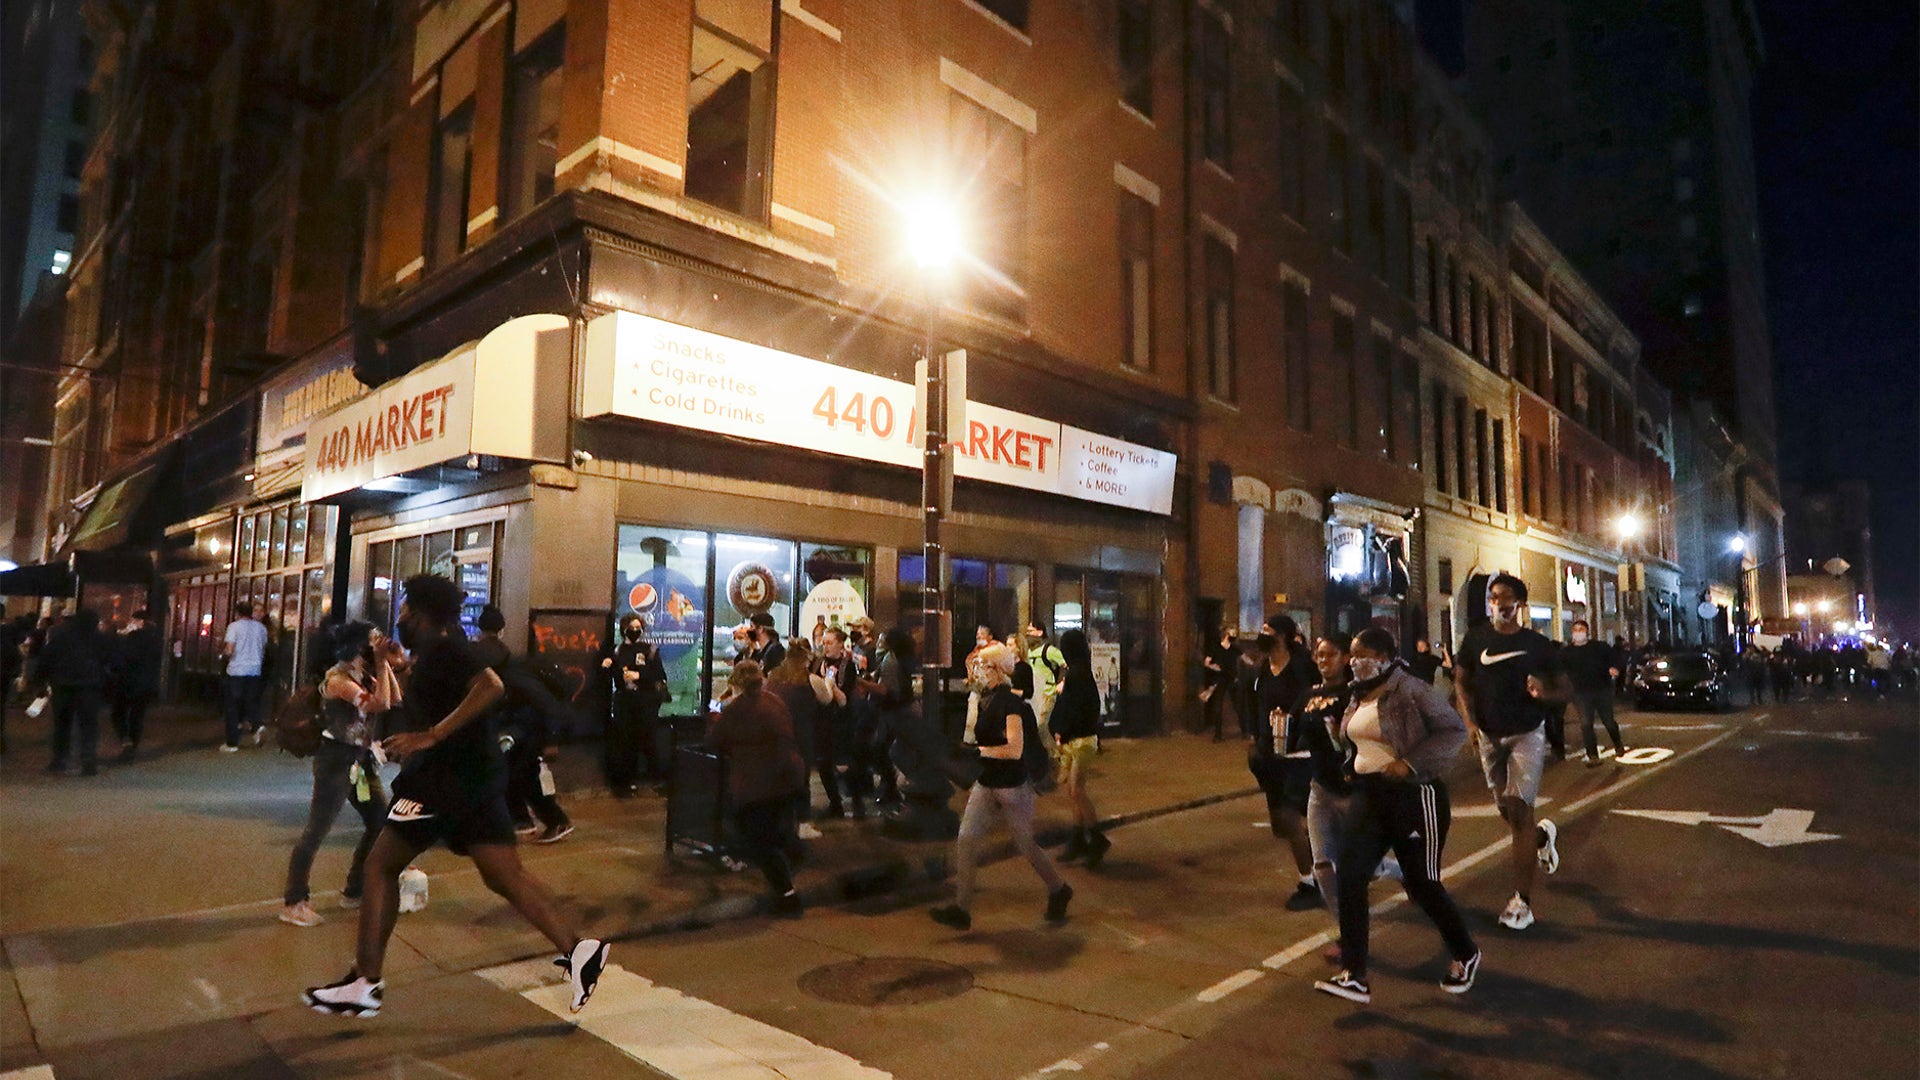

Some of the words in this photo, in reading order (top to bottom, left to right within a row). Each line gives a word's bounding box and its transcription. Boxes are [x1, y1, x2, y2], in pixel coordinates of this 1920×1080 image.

[653, 333, 726, 365] Snacks
[650, 359, 757, 396] Cigarettes
[649, 387, 696, 411] Cold
[703, 398, 766, 425] Drinks
[317, 425, 350, 475] 440
[353, 383, 456, 467] MARKET
[812, 385, 895, 438] 440
[906, 405, 1053, 473] RKET
[1087, 459, 1119, 476] Coffee
[1088, 440, 1125, 463] Lottery
[1126, 450, 1159, 469] Tickets
[1085, 478, 1092, 490] &
[1095, 479, 1127, 496] MORE!
[393, 798, 424, 816] NIKE
